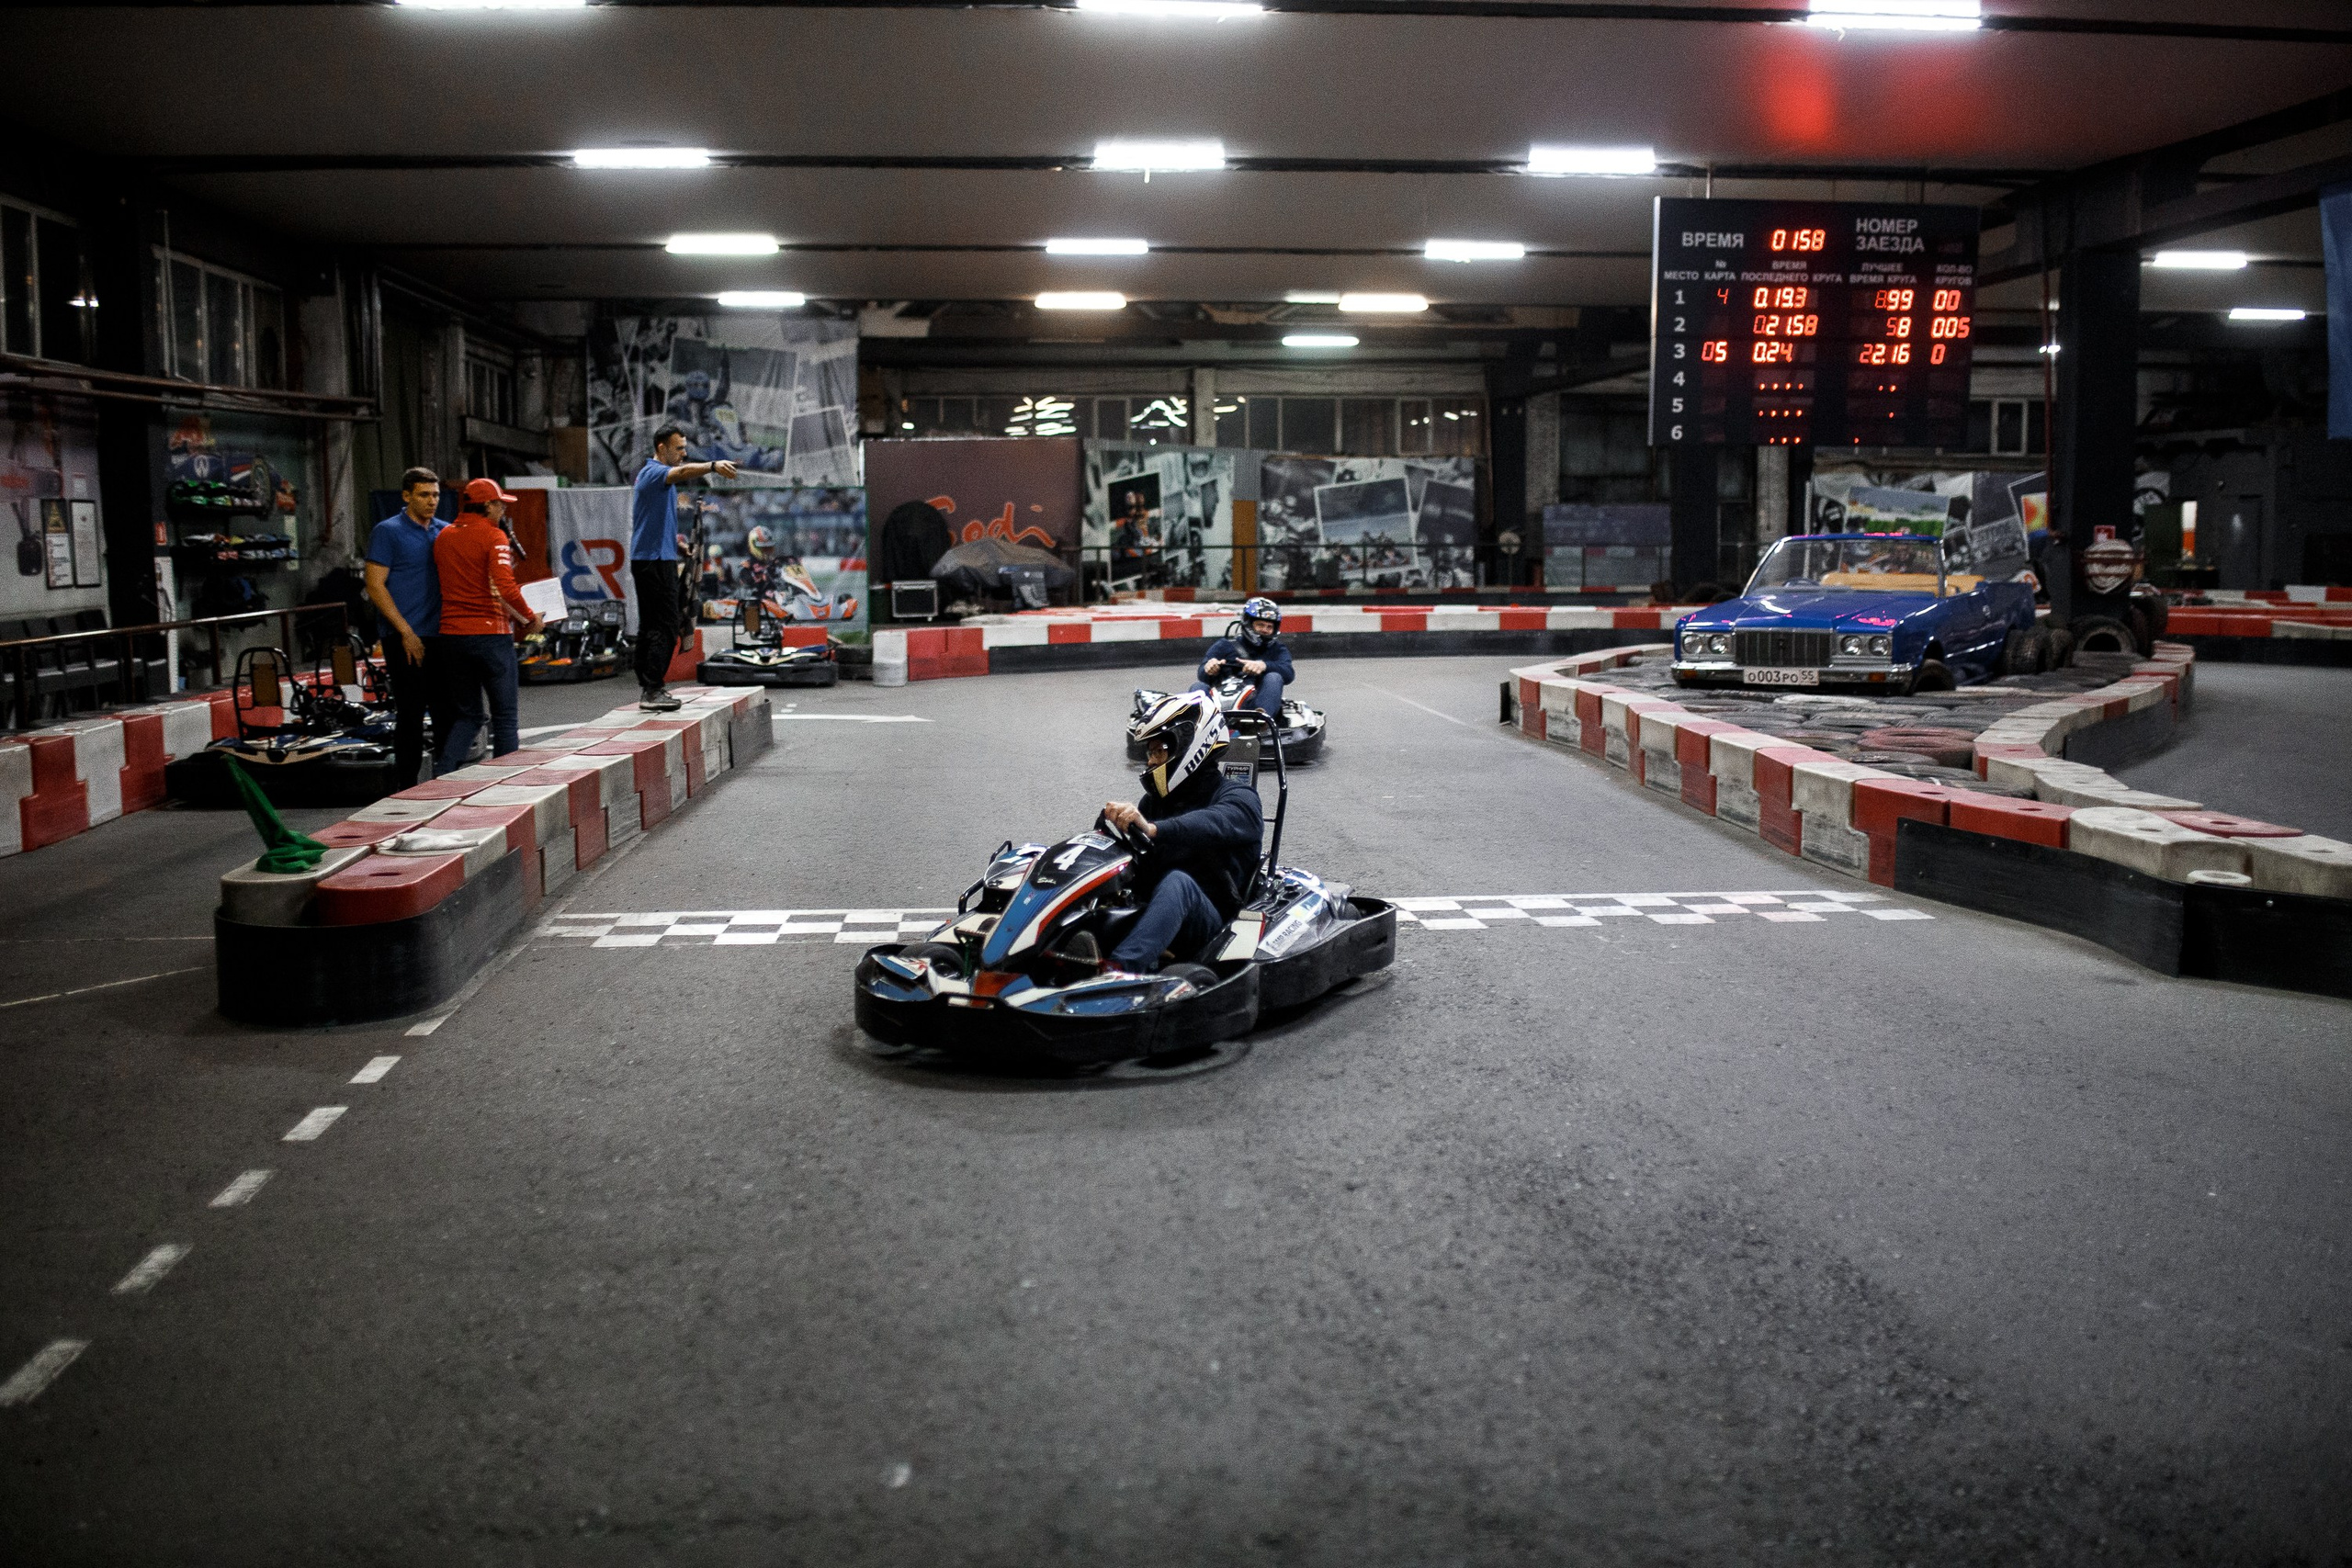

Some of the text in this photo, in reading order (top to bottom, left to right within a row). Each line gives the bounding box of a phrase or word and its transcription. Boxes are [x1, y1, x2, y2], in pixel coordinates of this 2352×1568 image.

[1856, 218, 1918, 233] НОМЕР
[1682, 231, 1744, 248] ВРЕМЯ
[1856, 235, 1925, 254] ЗАЕЗДА
[1772, 260, 1807, 270] ВРЕМЯ
[1664, 271, 1700, 281] МЕСТО
[1704, 271, 1736, 281] КАРТА
[1741, 272, 1843, 284] ПОСЛЕДНЕГО КРУГА
[1849, 274, 1917, 284] ВРЕМЯ КРУГА
[1675, 289, 1685, 305] 1
[1717, 288, 1729, 305] 4
[1674, 317, 1686, 333] 2
[1673, 344, 1686, 359] 3
[1702, 341, 1728, 362] 05
[1672, 370, 1685, 387] 4
[1671, 398, 1684, 413] 5
[1670, 425, 1683, 440] 6
[924, 495, 1056, 548] odi
[1053, 845, 1088, 871] 4
[1282, 919, 1303, 937] RACING
